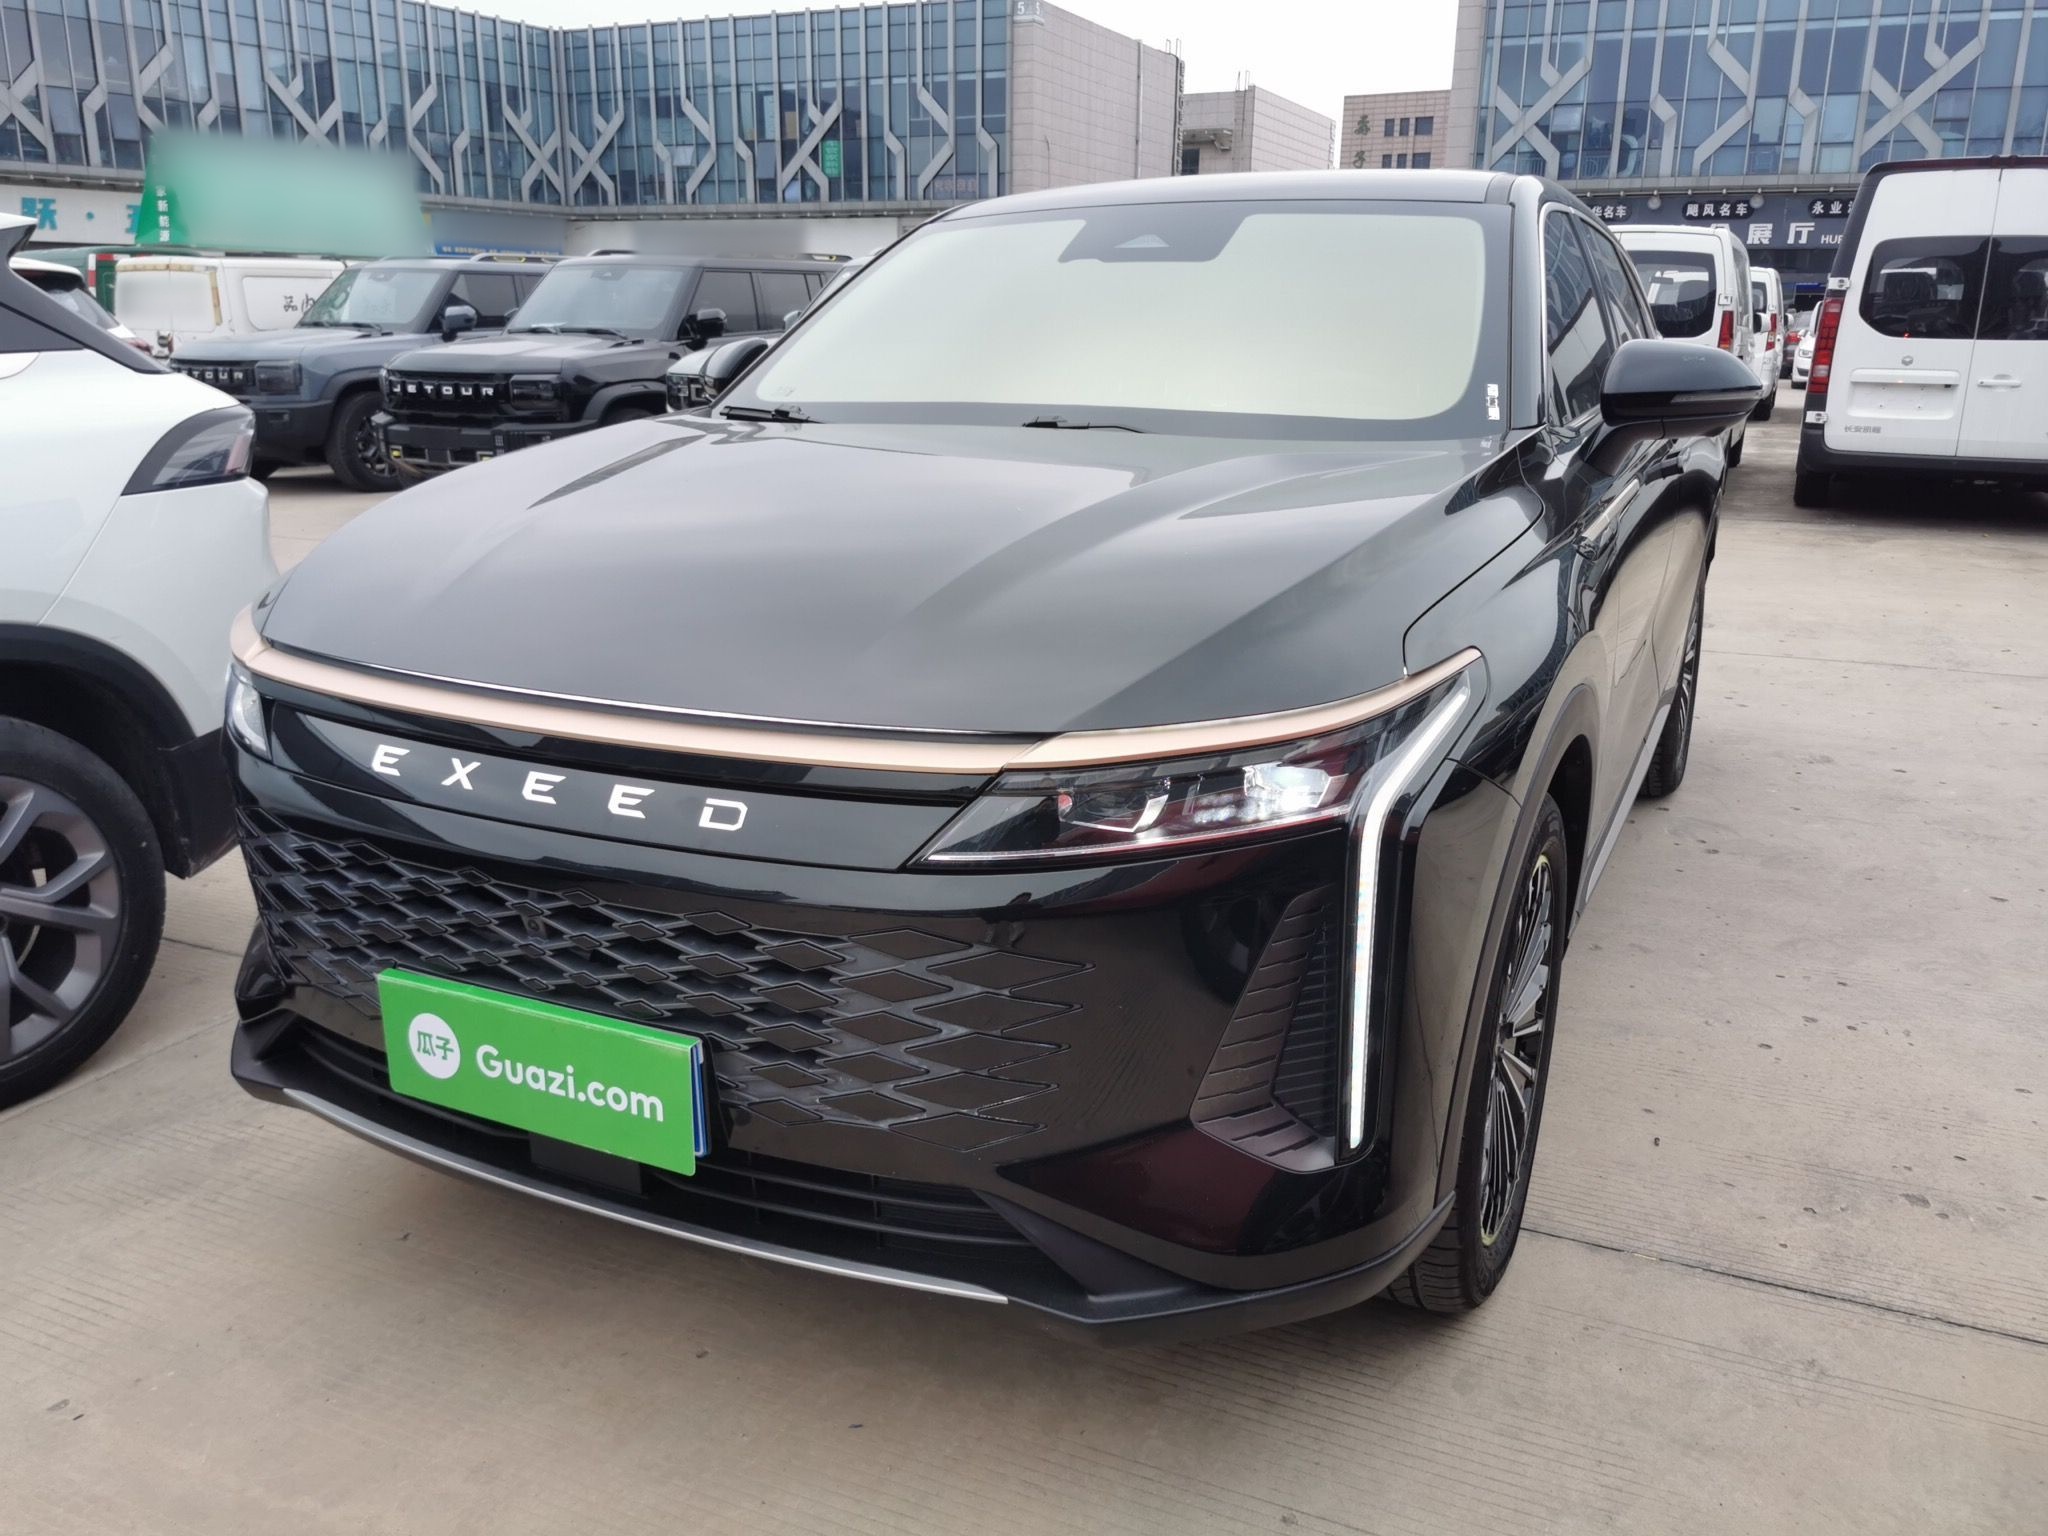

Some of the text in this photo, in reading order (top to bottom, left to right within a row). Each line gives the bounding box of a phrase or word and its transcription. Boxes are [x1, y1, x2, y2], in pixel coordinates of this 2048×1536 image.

[1017, 1, 1025, 15] 5
[1711, 222, 1815, 244] 展厅
[182, 370, 244, 379] TOUR
[392, 384, 494, 396] JETOUR
[371, 744, 748, 831] EXEED
[417, 1030, 454, 1060] 瓜子
[476, 1044, 664, 1122] Guazi.com
